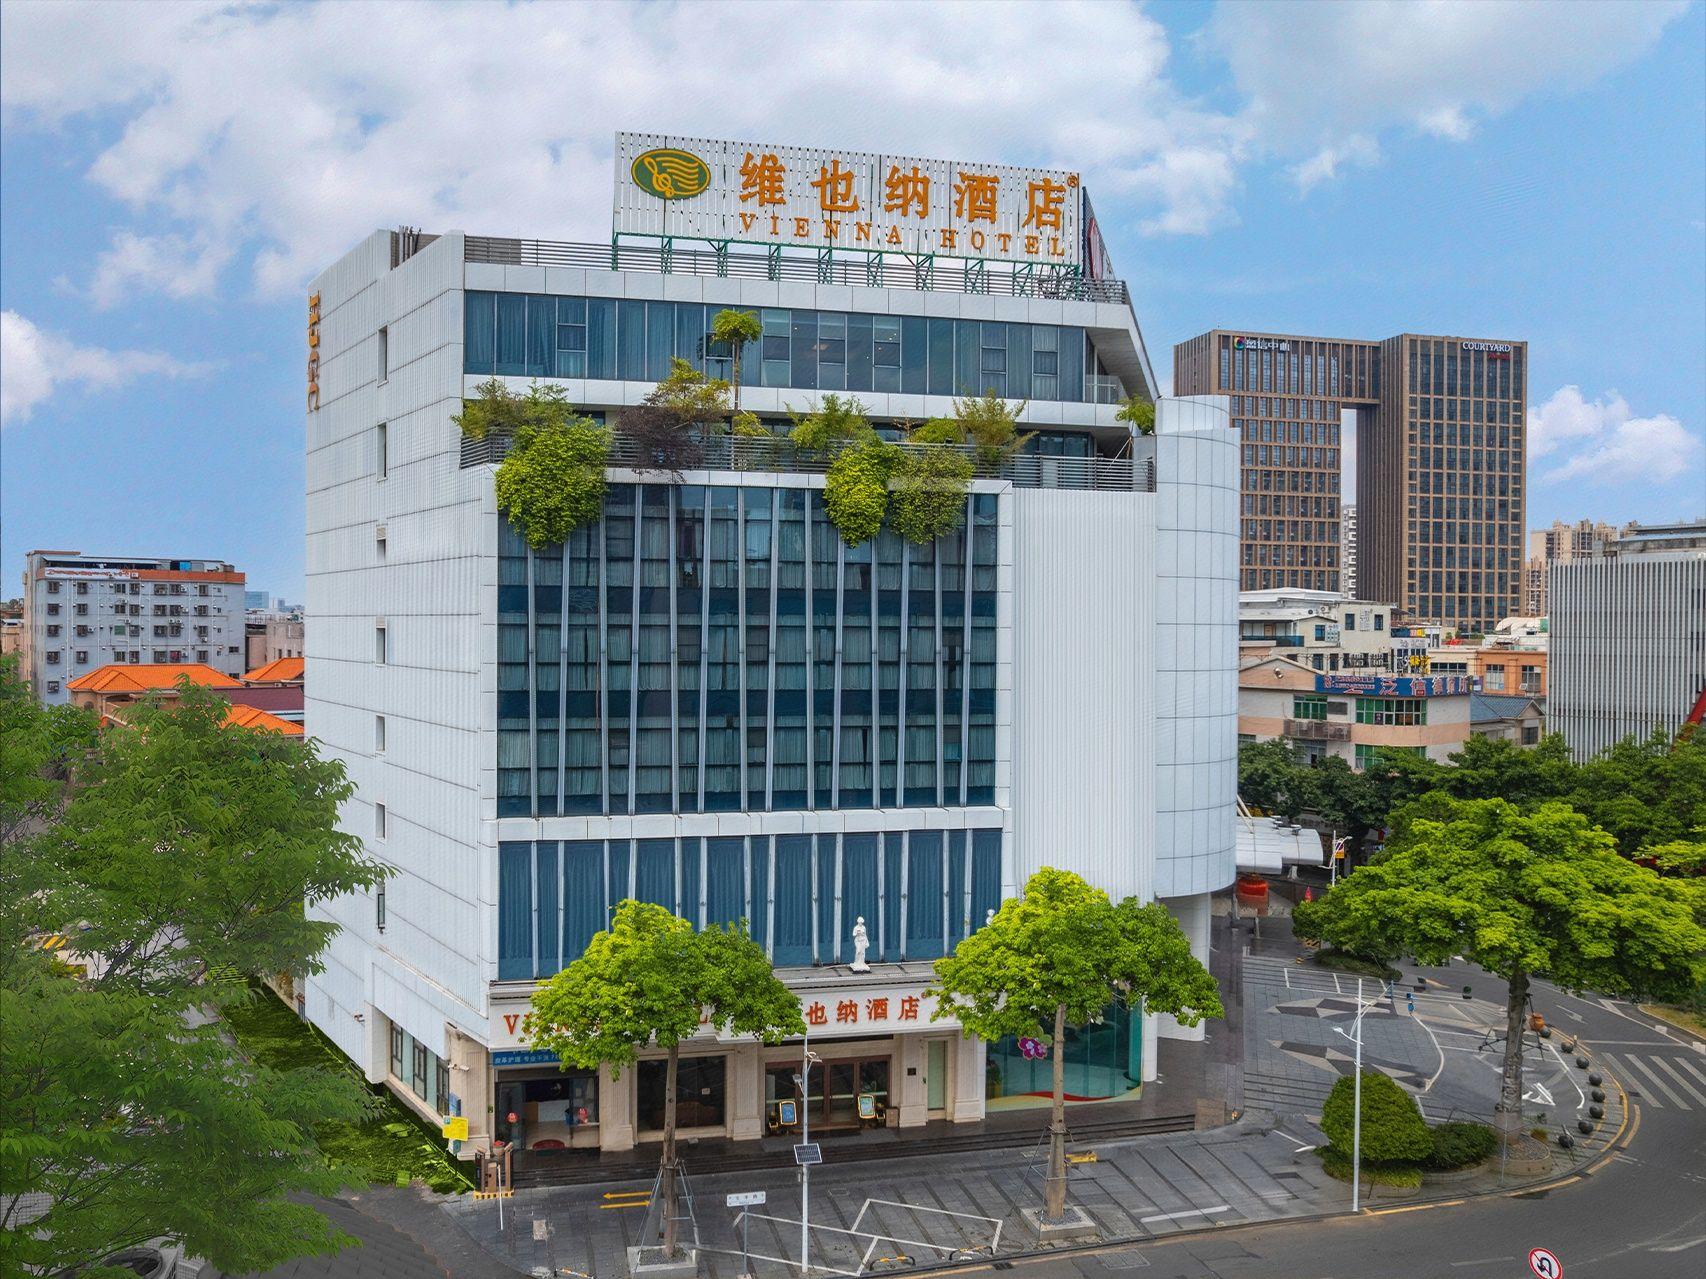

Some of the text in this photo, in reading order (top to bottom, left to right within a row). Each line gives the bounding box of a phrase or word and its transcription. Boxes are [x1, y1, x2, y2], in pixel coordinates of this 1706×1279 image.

[739, 151, 1068, 230] 维也纳酒店
[739, 212, 1066, 257] VIENNA HOTEL
[1462, 341, 1511, 352] COURTYARD
[805, 995, 920, 1025] 也纳酒店
